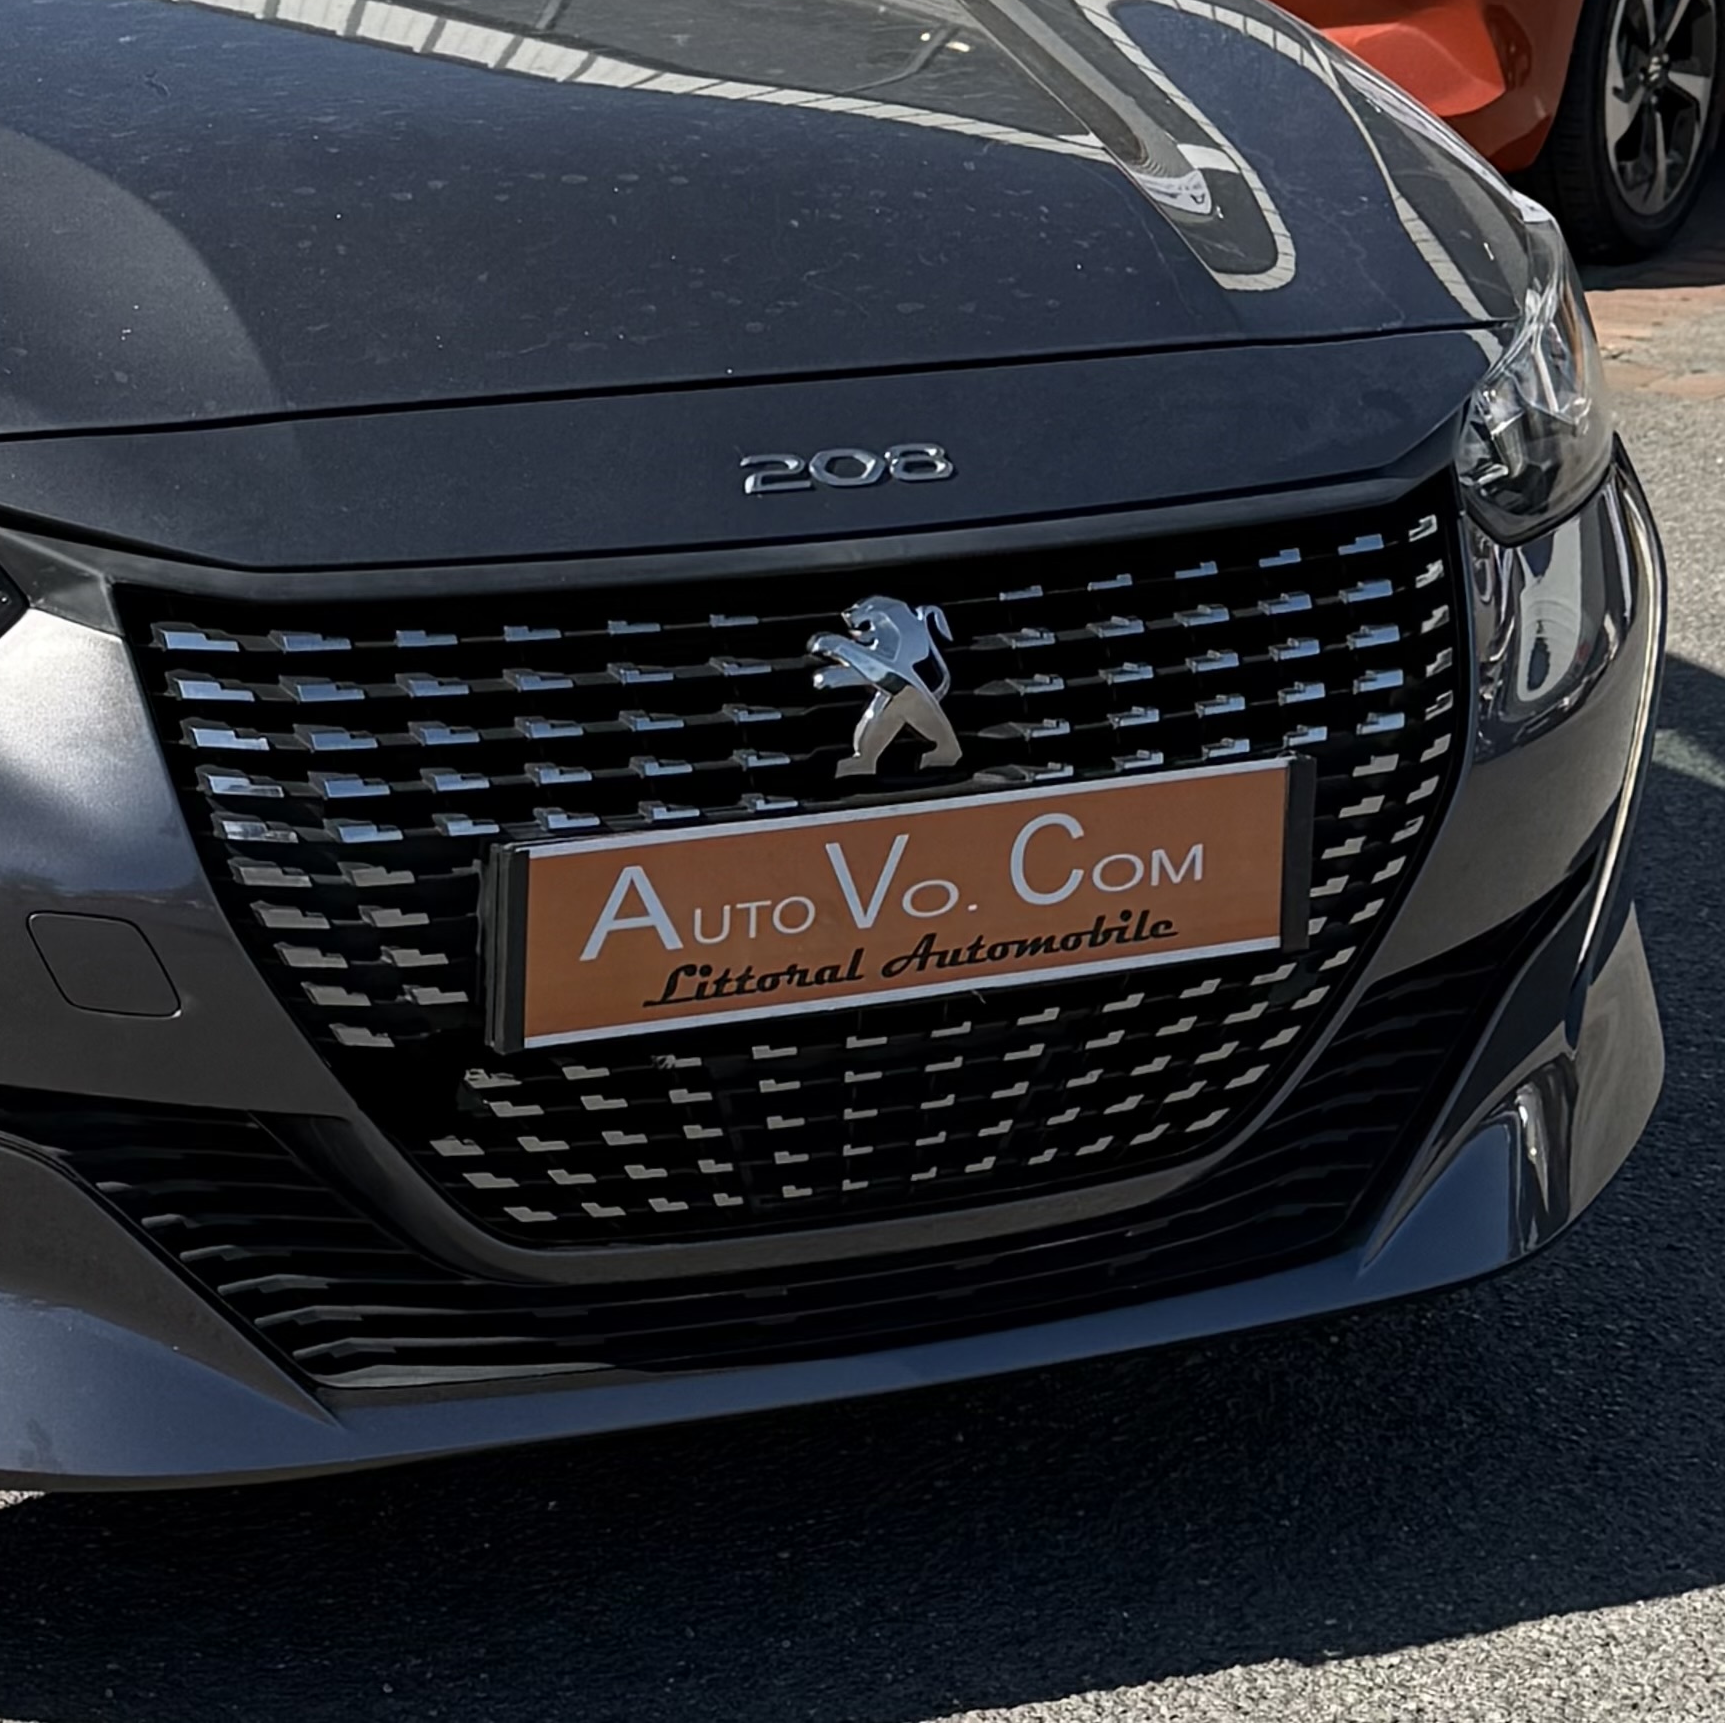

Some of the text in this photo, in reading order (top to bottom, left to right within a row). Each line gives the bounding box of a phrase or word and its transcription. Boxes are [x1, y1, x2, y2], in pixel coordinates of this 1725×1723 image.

[739, 442, 955, 495] 208
[642, 909, 1180, 1008] Littoral Automobile
